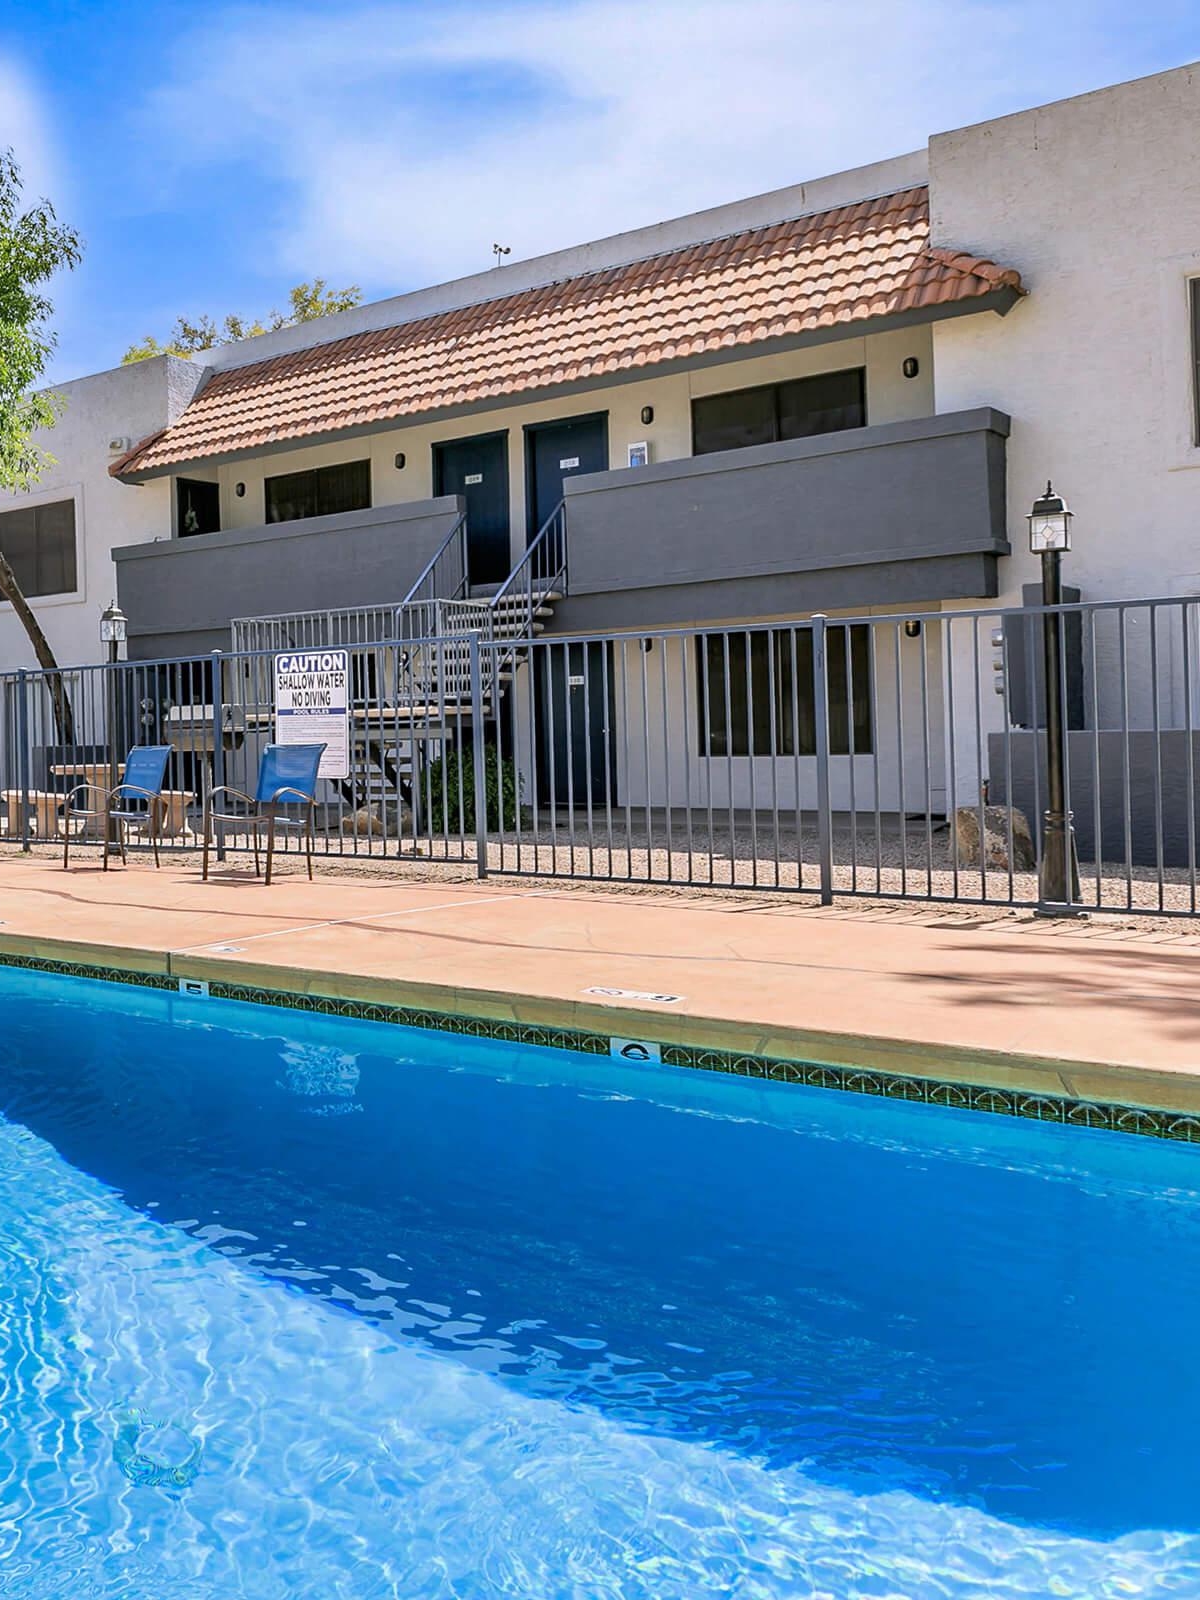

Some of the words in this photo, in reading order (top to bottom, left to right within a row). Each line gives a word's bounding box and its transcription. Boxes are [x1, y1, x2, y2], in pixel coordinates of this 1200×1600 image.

[279, 653, 343, 673] CAUTION
[279, 673, 315, 690] SHALLOW
[317, 672, 345, 688] WATER
[292, 692, 303, 707] NO
[305, 690, 331, 706] DIVING
